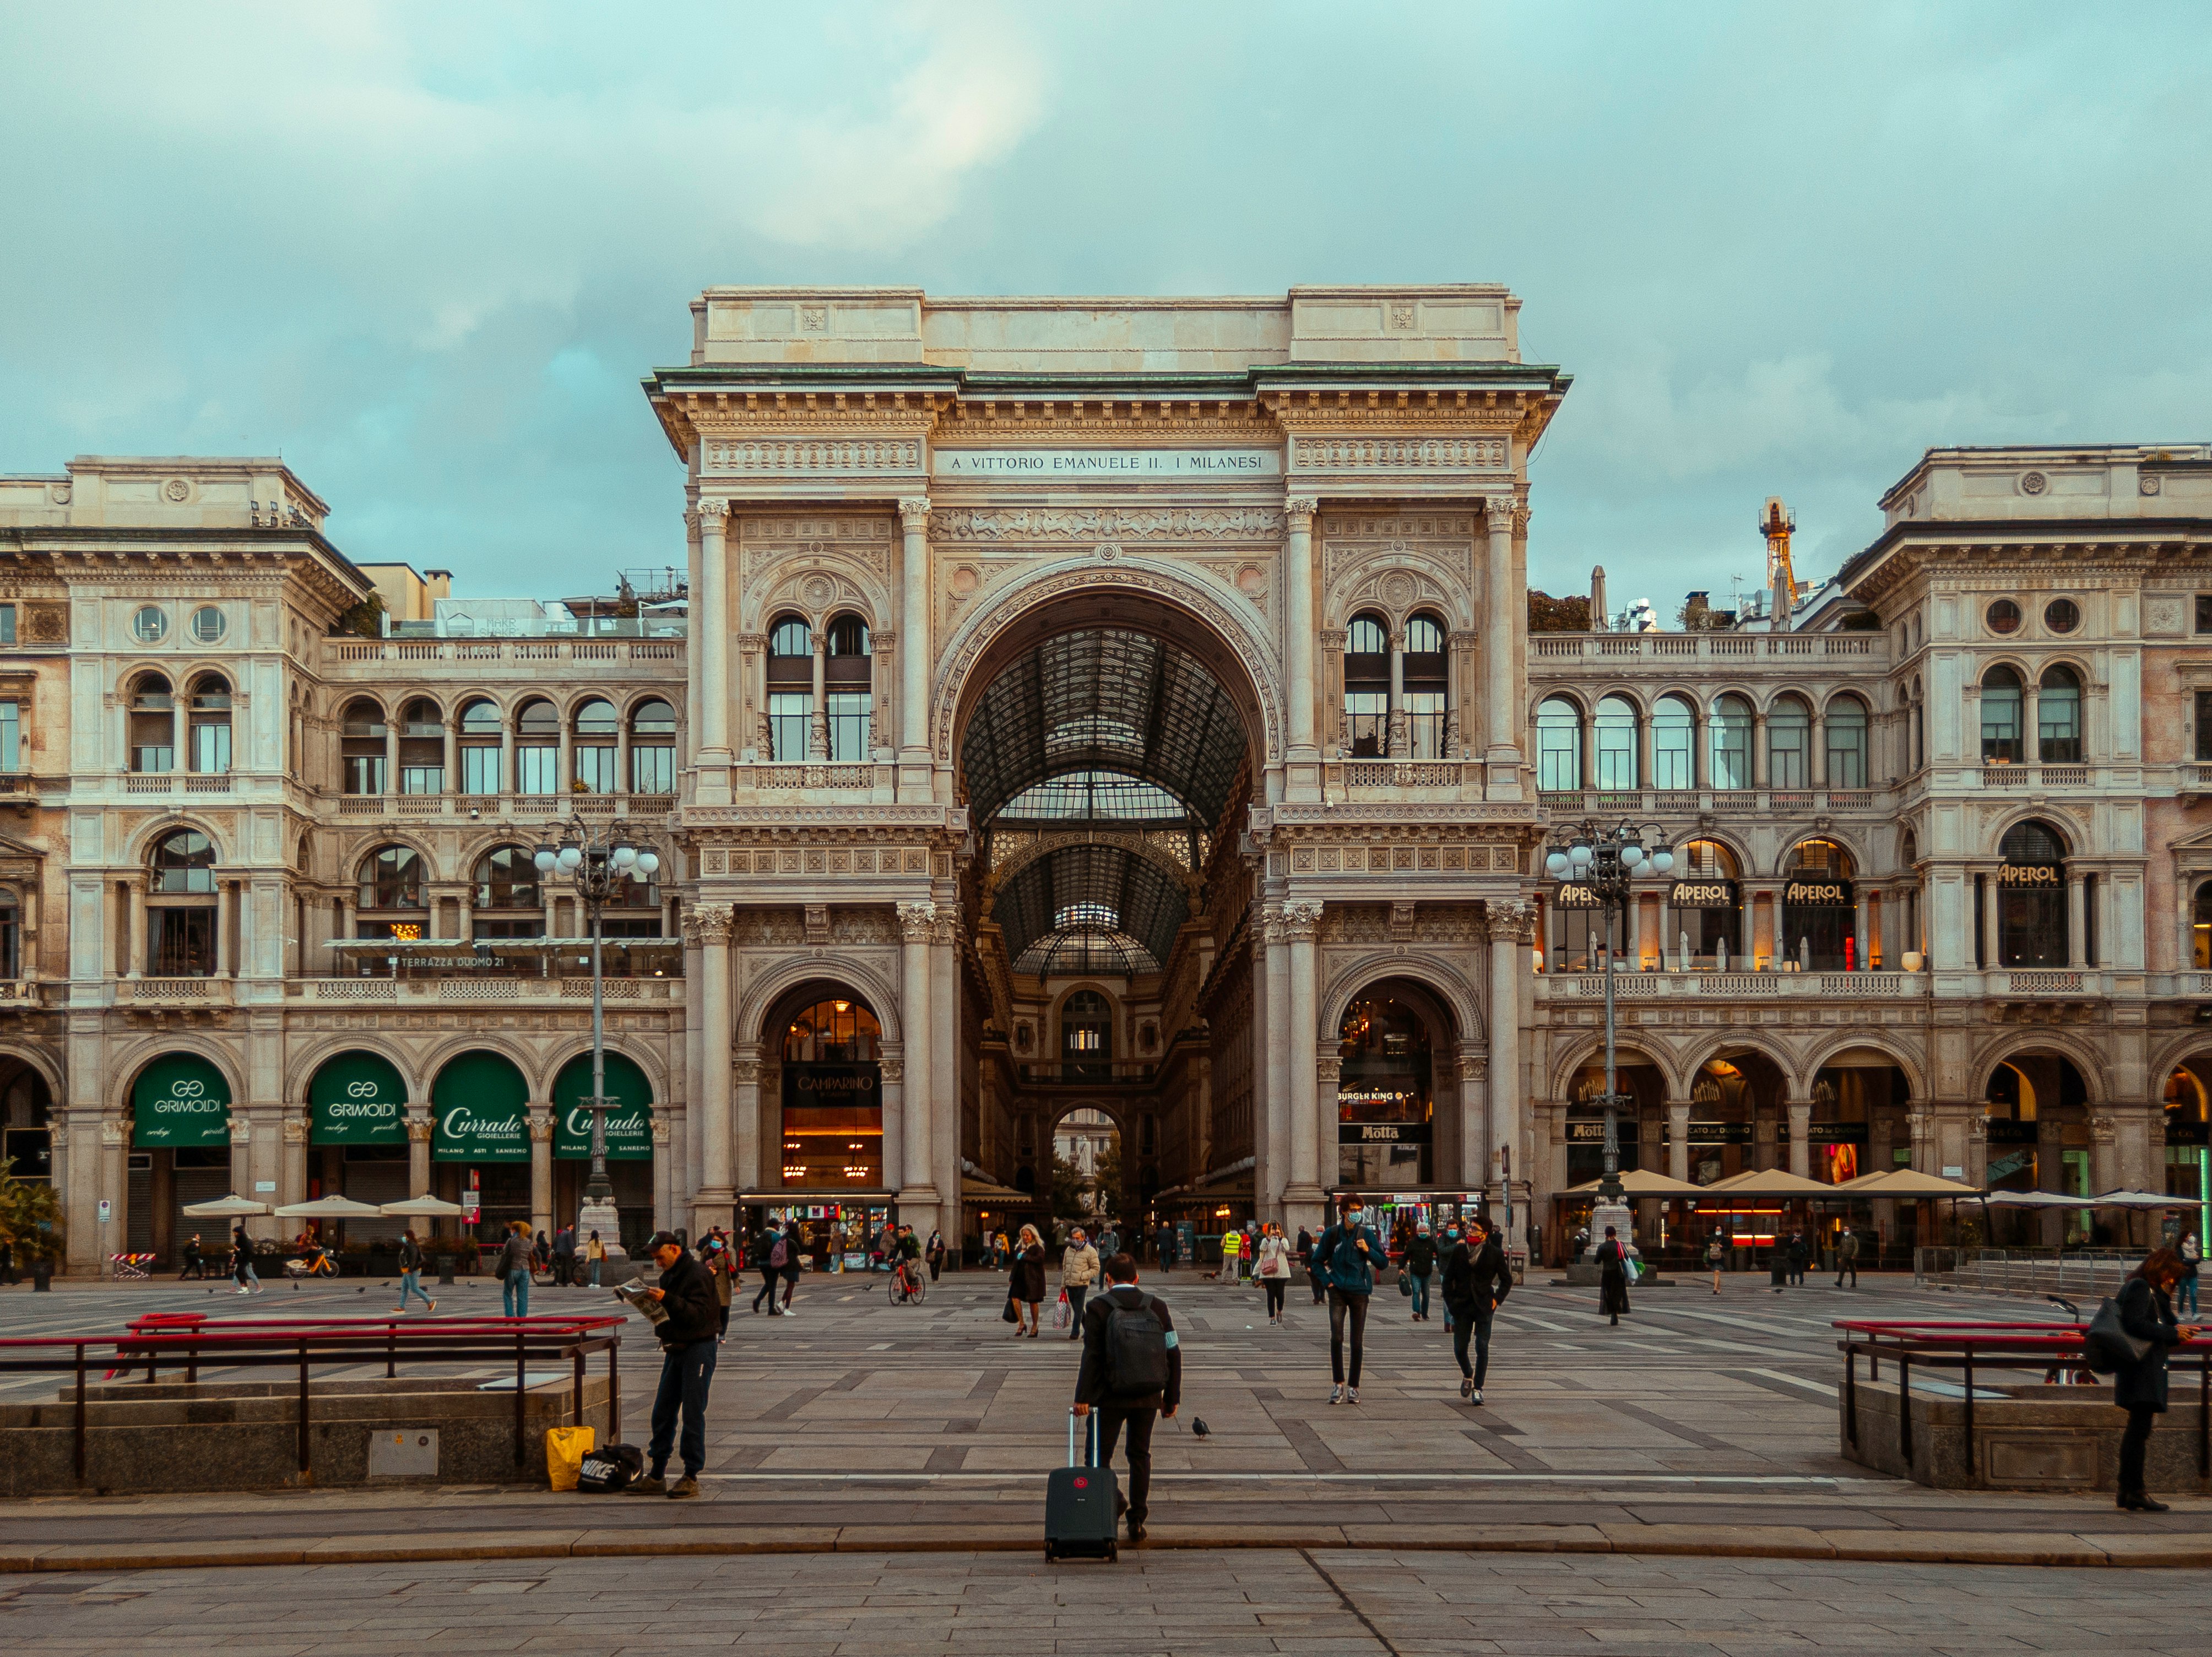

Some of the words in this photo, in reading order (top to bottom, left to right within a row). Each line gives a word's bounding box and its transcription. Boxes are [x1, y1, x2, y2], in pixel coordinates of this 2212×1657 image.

[952, 458, 961, 468] A
[972, 458, 1044, 469] VITTORIO
[1054, 458, 1140, 469] EMANUELE
[1149, 458, 1163, 468] II.
[1177, 458, 1180, 468] I
[1190, 457, 1262, 468] MILANESI
[487, 618, 517, 627] MAKR
[1997, 864, 2058, 882] APEROL
[1673, 883, 1730, 900] APEROL
[1787, 882, 1845, 900] APEROL
[402, 959, 453, 967] TERRAZZA
[458, 958, 492, 967] DUOMO
[495, 958, 504, 966] 21
[798, 1076, 873, 1090] CAMPARINO
[155, 1100, 220, 1113] GRIMOLDI
[329, 1103, 396, 1117] GRIMOLDI
[443, 1107, 522, 1138] Currado
[1362, 1126, 1399, 1139] Motta
[1573, 1124, 1605, 1138] Mott
[581, 1459, 616, 1480] NIKE
